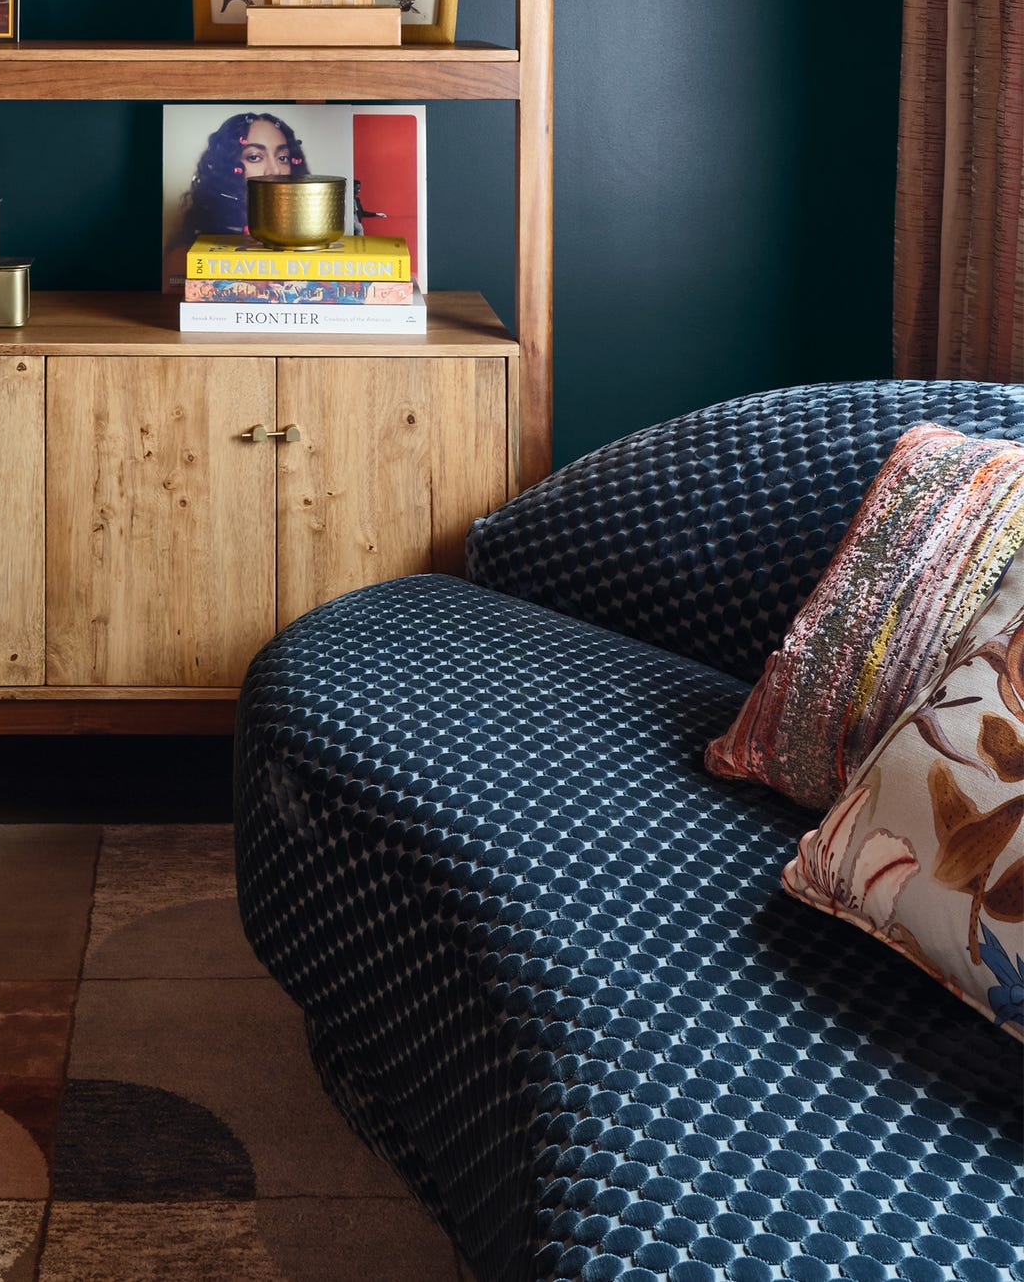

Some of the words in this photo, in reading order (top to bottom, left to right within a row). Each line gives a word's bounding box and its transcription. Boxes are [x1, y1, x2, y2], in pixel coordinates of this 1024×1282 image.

[196, 258, 204, 274] DLN
[207, 259, 281, 275] TRAVEL
[287, 260, 312, 275] BY
[318, 260, 393, 276] DESIGN
[236, 312, 319, 324] FRONTIER
